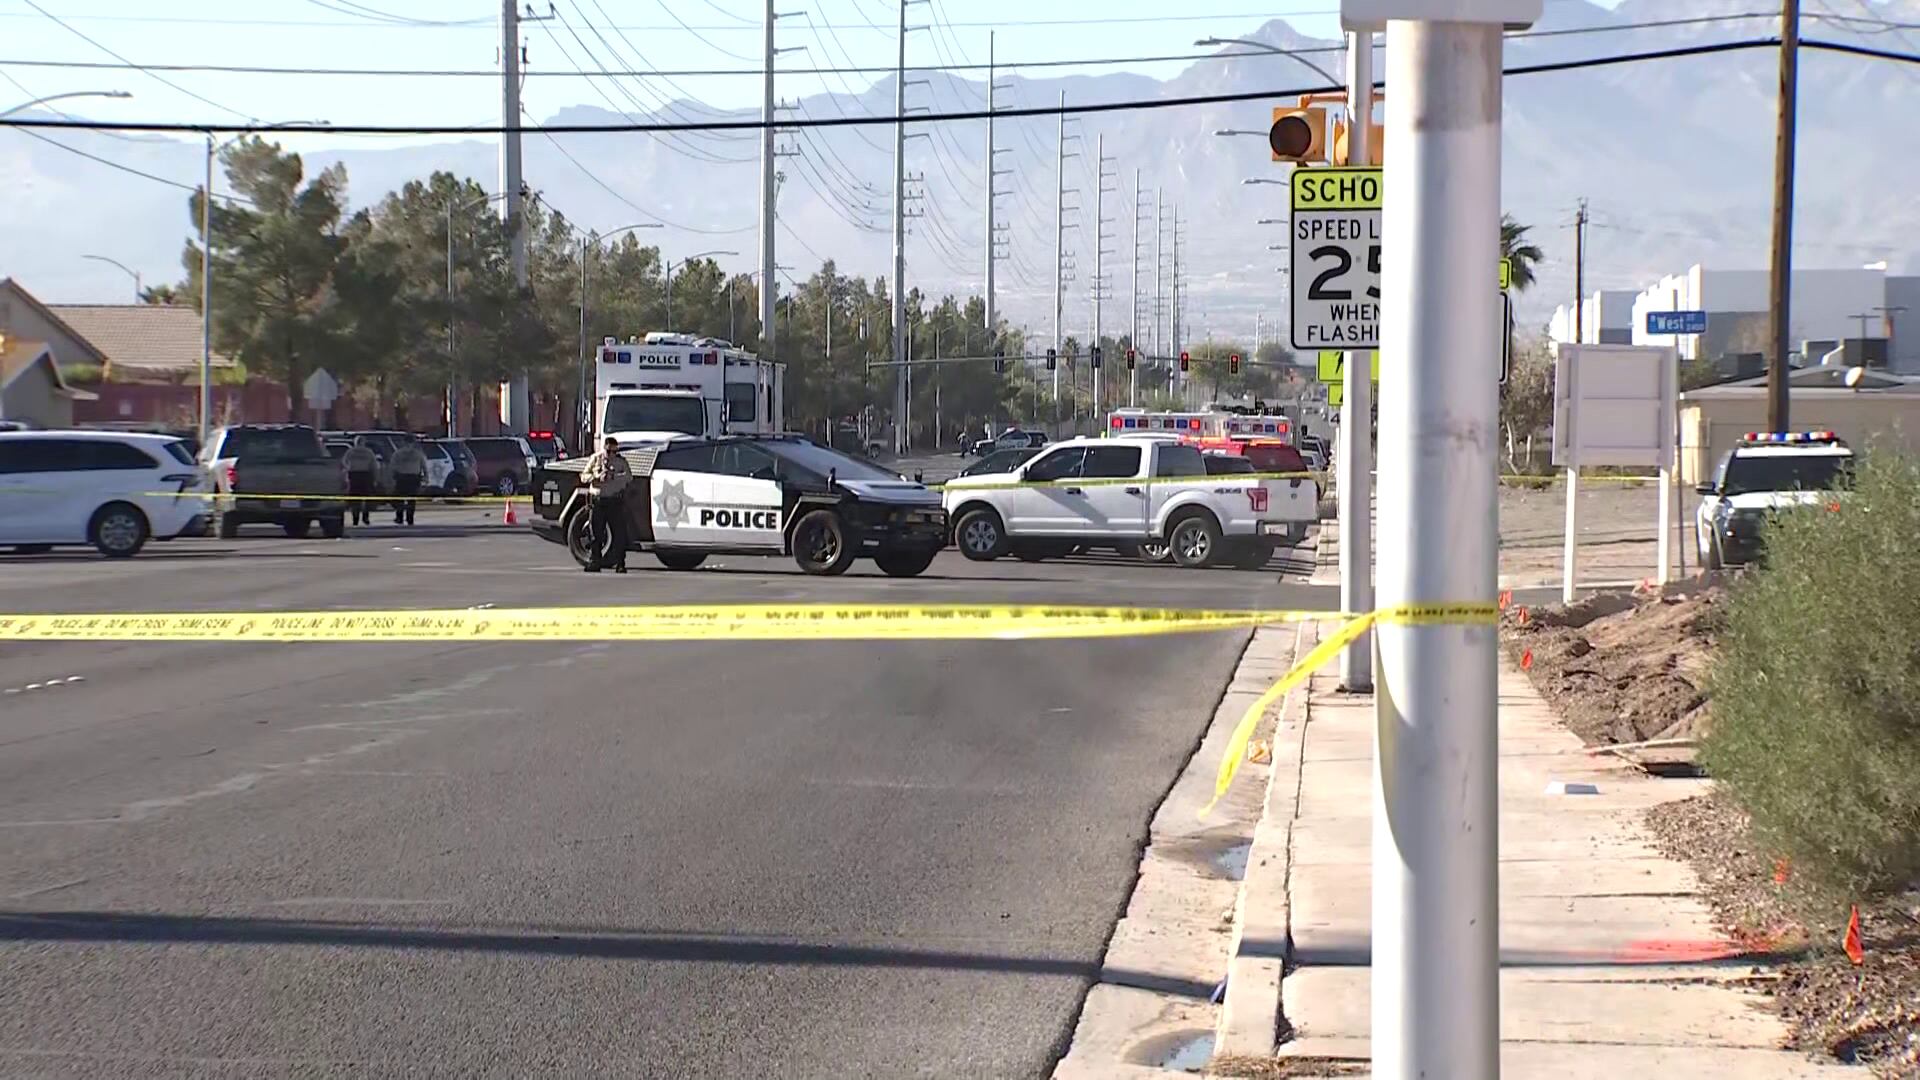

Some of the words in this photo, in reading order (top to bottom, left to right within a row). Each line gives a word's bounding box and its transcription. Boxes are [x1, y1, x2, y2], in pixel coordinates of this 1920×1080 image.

[1301, 177, 1377, 202] SCHO
[1298, 219, 1361, 240] SPEED
[1369, 218, 1380, 240] L
[1657, 316, 1684, 330] West
[640, 355, 681, 365] POLICE
[700, 509, 777, 529] POLICE
